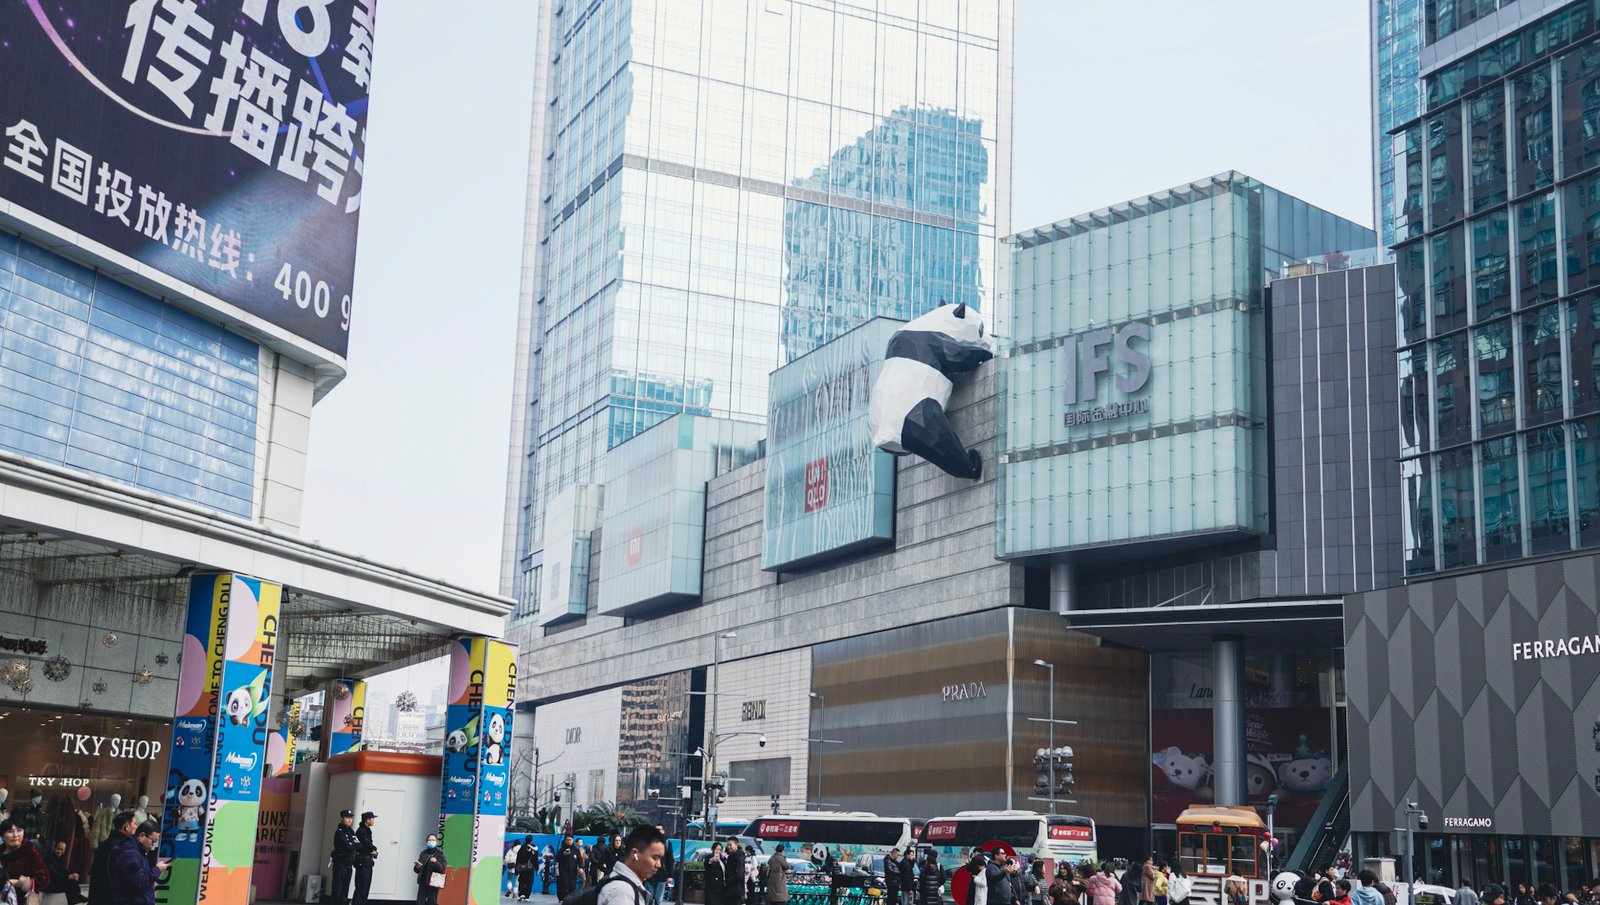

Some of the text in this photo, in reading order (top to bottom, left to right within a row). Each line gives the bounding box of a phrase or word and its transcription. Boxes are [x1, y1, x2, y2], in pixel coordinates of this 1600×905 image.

[122, 0, 367, 213] 传播跨
[274, 262, 331, 319] 400
[1064, 322, 1152, 405] IFS
[1063, 399, 1148, 428] 国际金融中心
[220, 582, 230, 605] DU
[214, 607, 228, 656] CHENG
[212, 659, 222, 677] TO
[942, 681, 986, 701] PRADA
[61, 733, 161, 760] TKY SHOP
[565, 726, 581, 745] DIOR
[28, 777, 55, 786] TKY
[1444, 817, 1492, 828] FERRAGAMO
